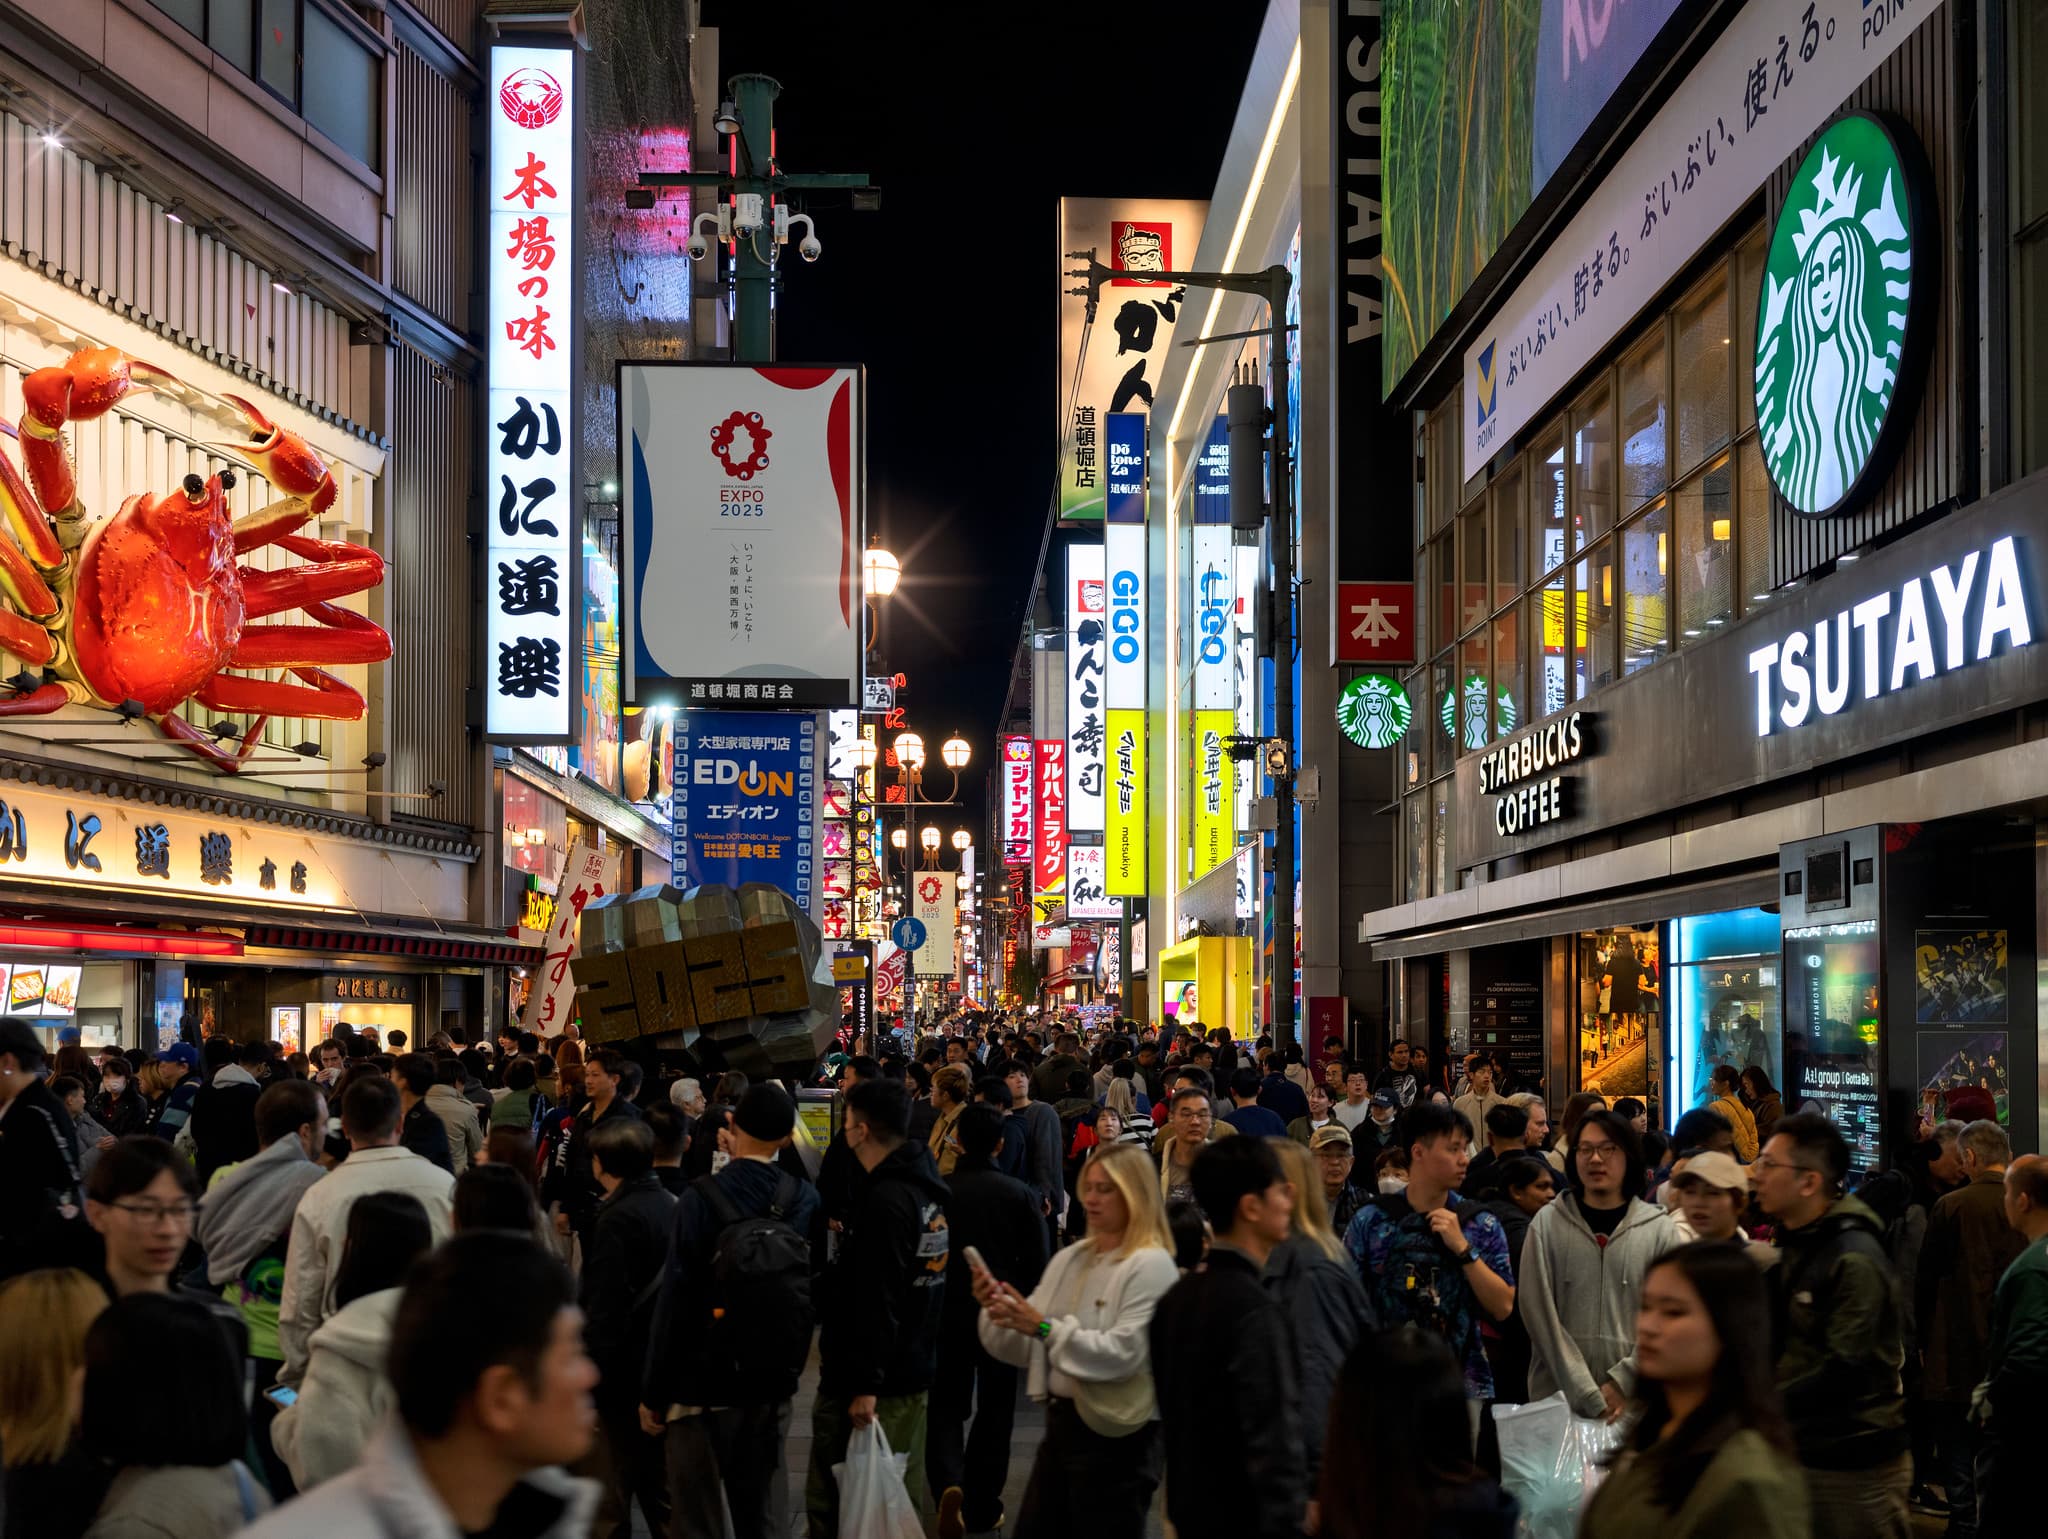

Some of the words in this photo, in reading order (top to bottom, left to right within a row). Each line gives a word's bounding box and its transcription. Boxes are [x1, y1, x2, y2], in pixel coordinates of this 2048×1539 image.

[502, 152, 558, 361] 本場の味
[1075, 406, 1097, 488] 道頓堀店
[1477, 418, 1497, 453] POINT
[720, 489, 764, 503] EXPO
[1110, 465, 1130, 477] Za
[720, 503, 764, 517] 2025
[1112, 570, 1139, 664] GiGO
[1350, 597, 1400, 648] 本
[1748, 535, 2033, 736] TSUTAYA
[691, 683, 794, 699] 道頓堀商店会
[698, 736, 791, 751] 大型家電専門店
[1479, 711, 1582, 795] STARBUCKS
[693, 759, 794, 797] EDION
[1115, 730, 1136, 815] マツモトキヨシ
[706, 804, 779, 820] エディオン
[1010, 764, 1029, 856] ジャンカラ
[1042, 743, 1065, 874] ツルハドラッグ
[1495, 777, 1561, 837] COFFEE
[1121, 826, 1129, 878] matsukiyo
[1818, 1071, 1840, 1088] group
